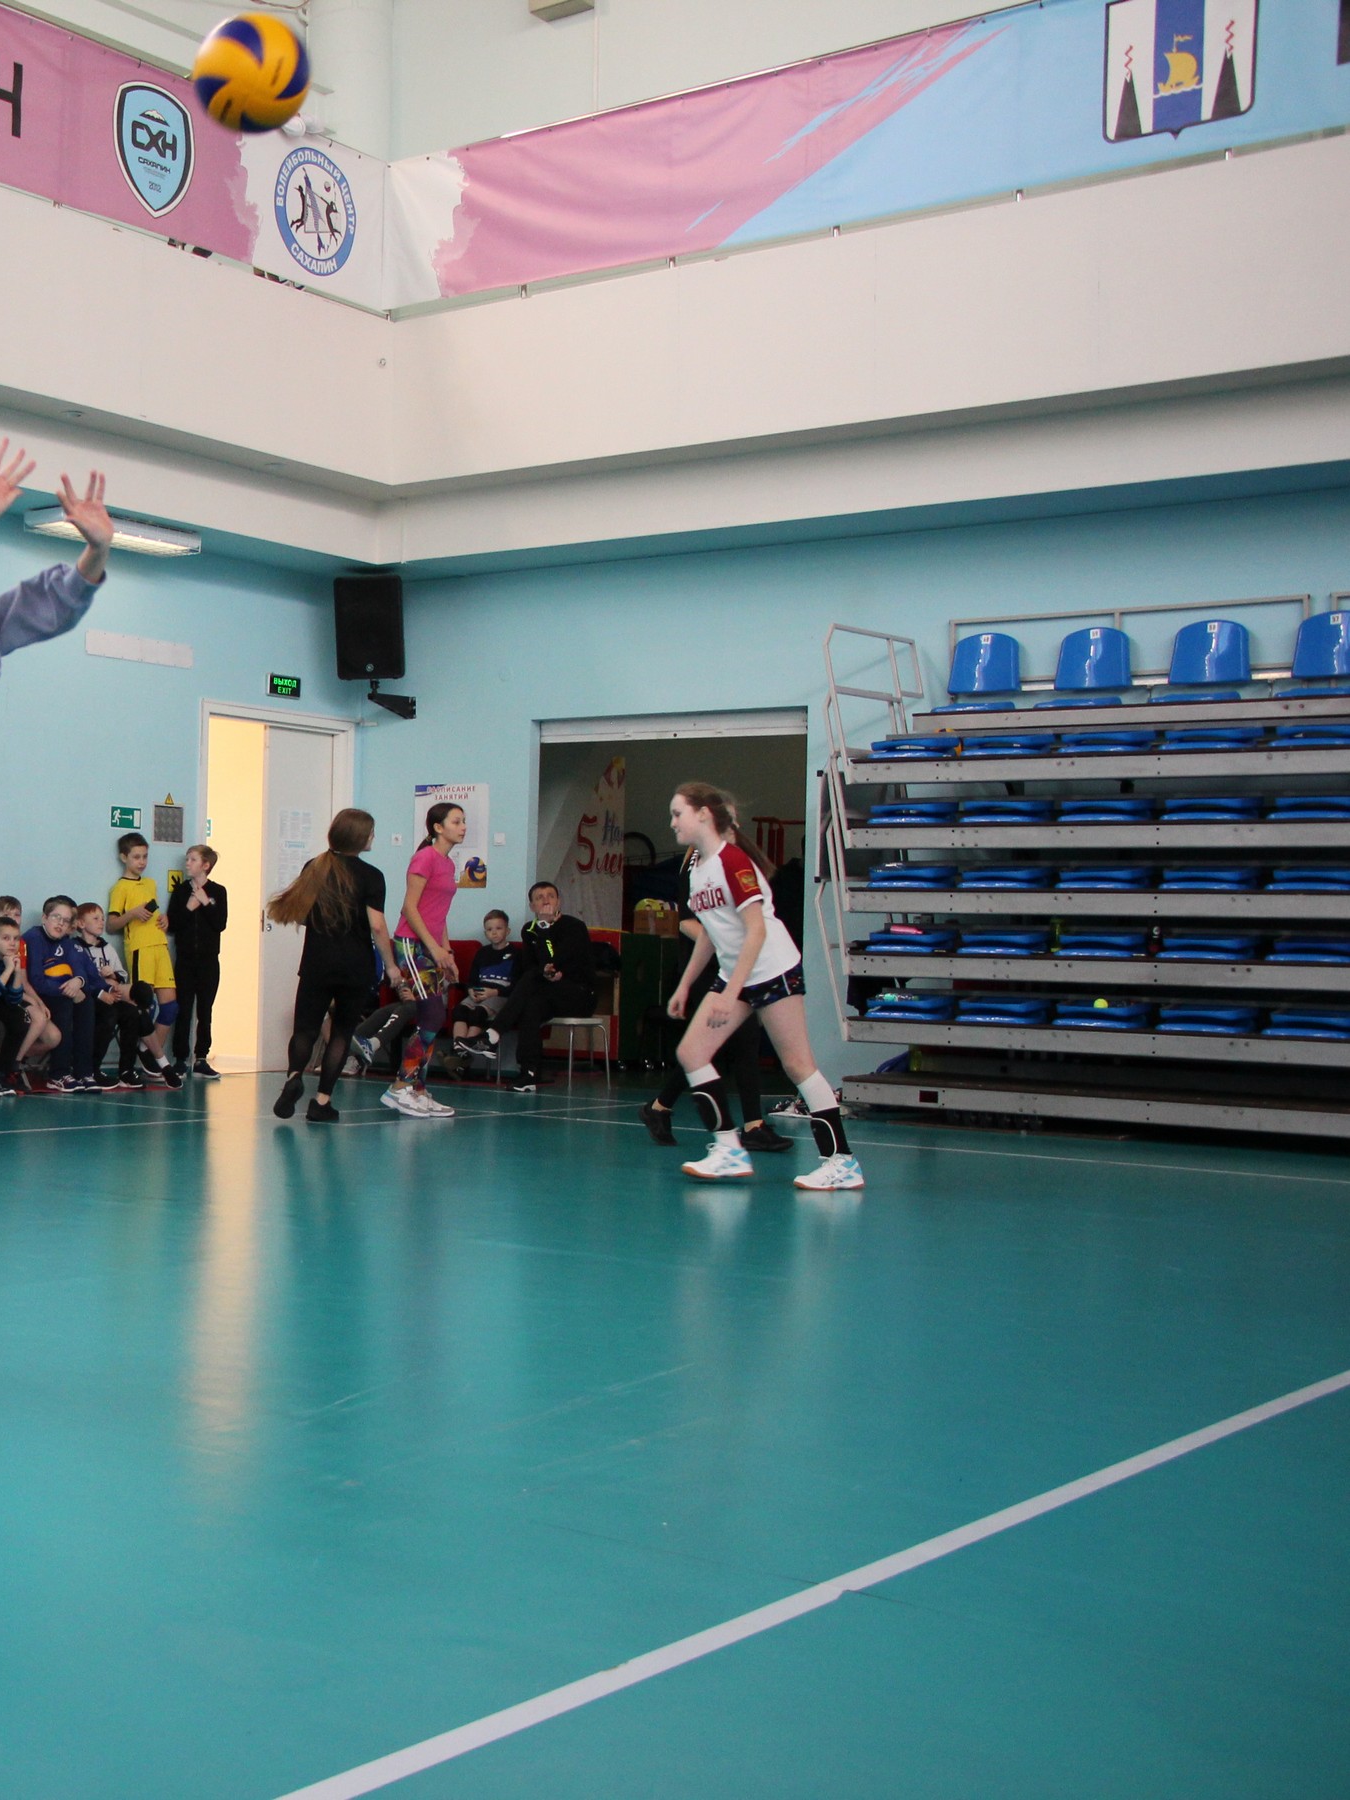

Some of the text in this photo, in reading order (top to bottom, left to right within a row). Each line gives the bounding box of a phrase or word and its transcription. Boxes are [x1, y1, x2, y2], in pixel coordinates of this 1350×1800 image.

[131, 120, 177, 161] СХН
[276, 150, 355, 235] ВОЛЕЙБОЛЬНЫЙ ЦЕНТР
[290, 243, 338, 274] САХАЛИН
[273, 677, 297, 688] ВЫХОД
[277, 686, 292, 695] EXIT
[434, 793, 469, 801] ЗАНЯТИЙ
[576, 813, 597, 873] 5
